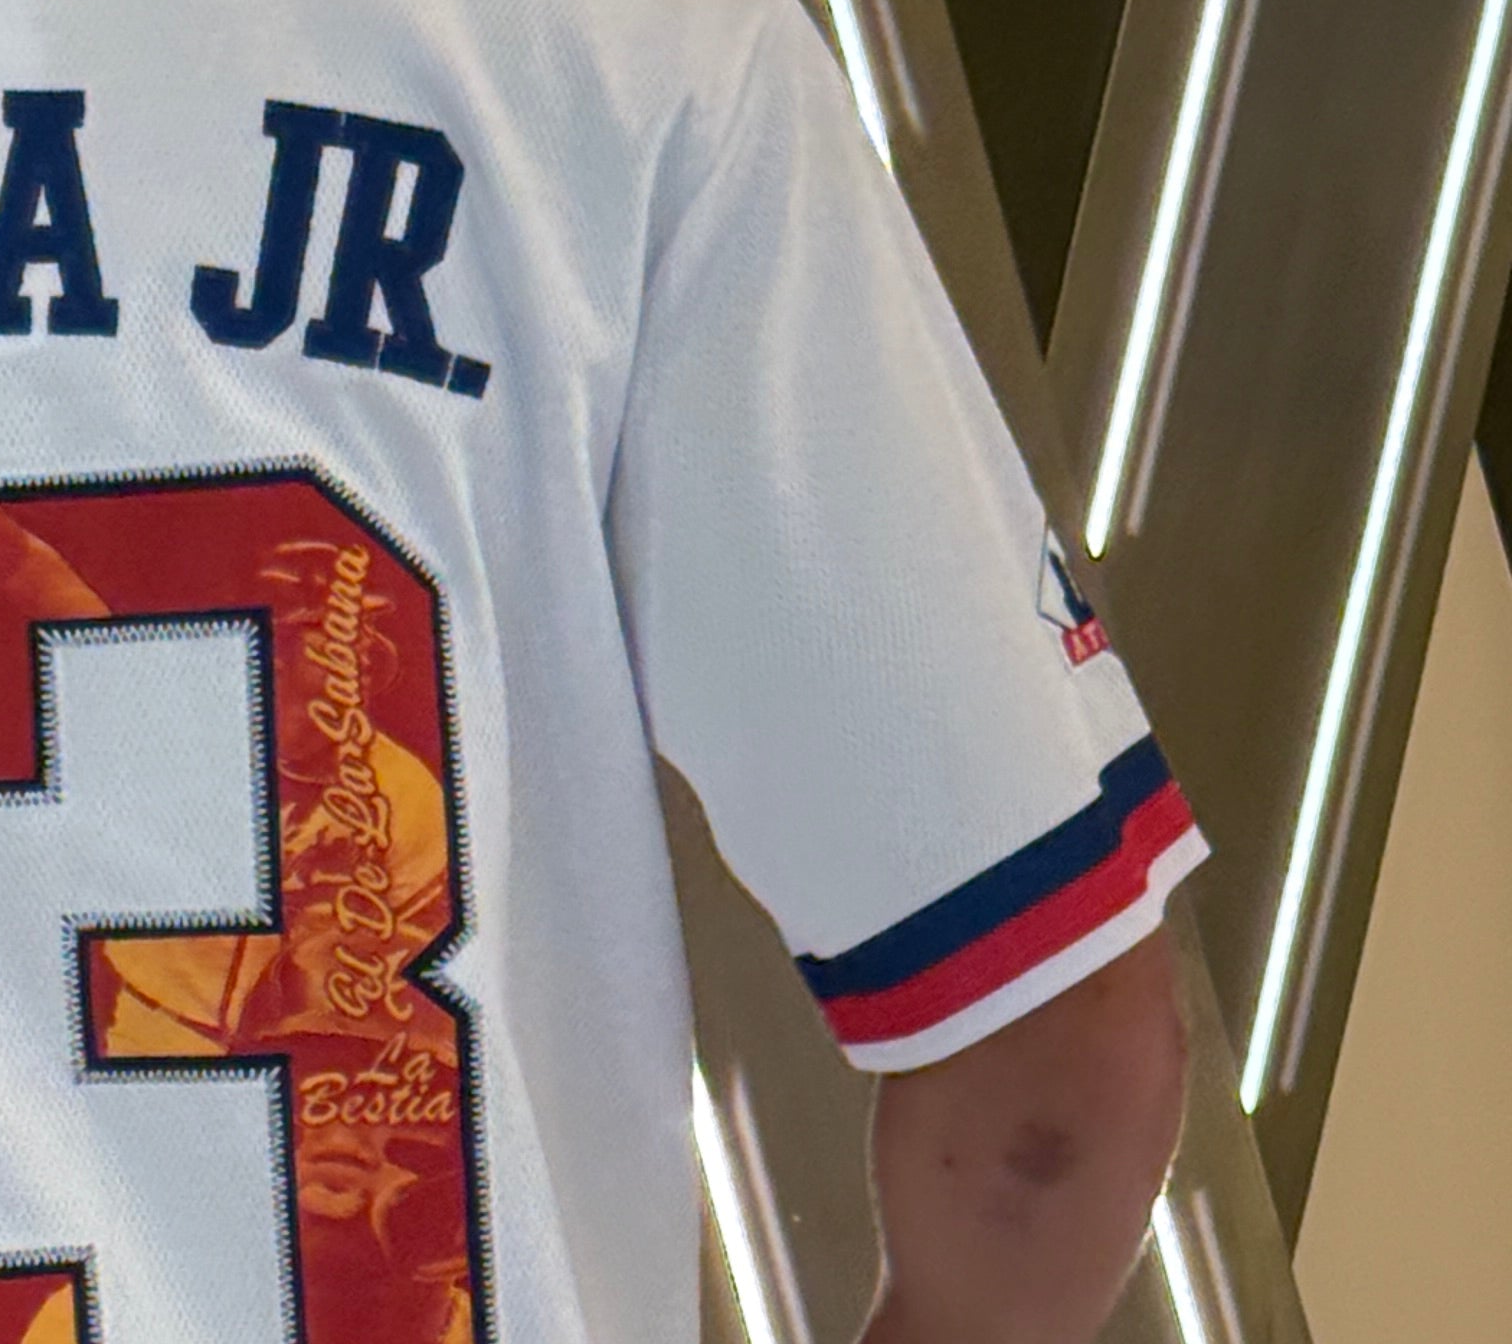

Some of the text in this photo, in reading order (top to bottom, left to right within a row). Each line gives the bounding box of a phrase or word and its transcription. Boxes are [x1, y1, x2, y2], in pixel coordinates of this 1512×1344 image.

[189, 98, 492, 400] JR.
[305, 542, 373, 746] Sabana
[322, 758, 390, 850] La
[336, 862, 395, 941] De
[299, 1072, 456, 1126] Bestia
[353, 1031, 436, 1086] La
